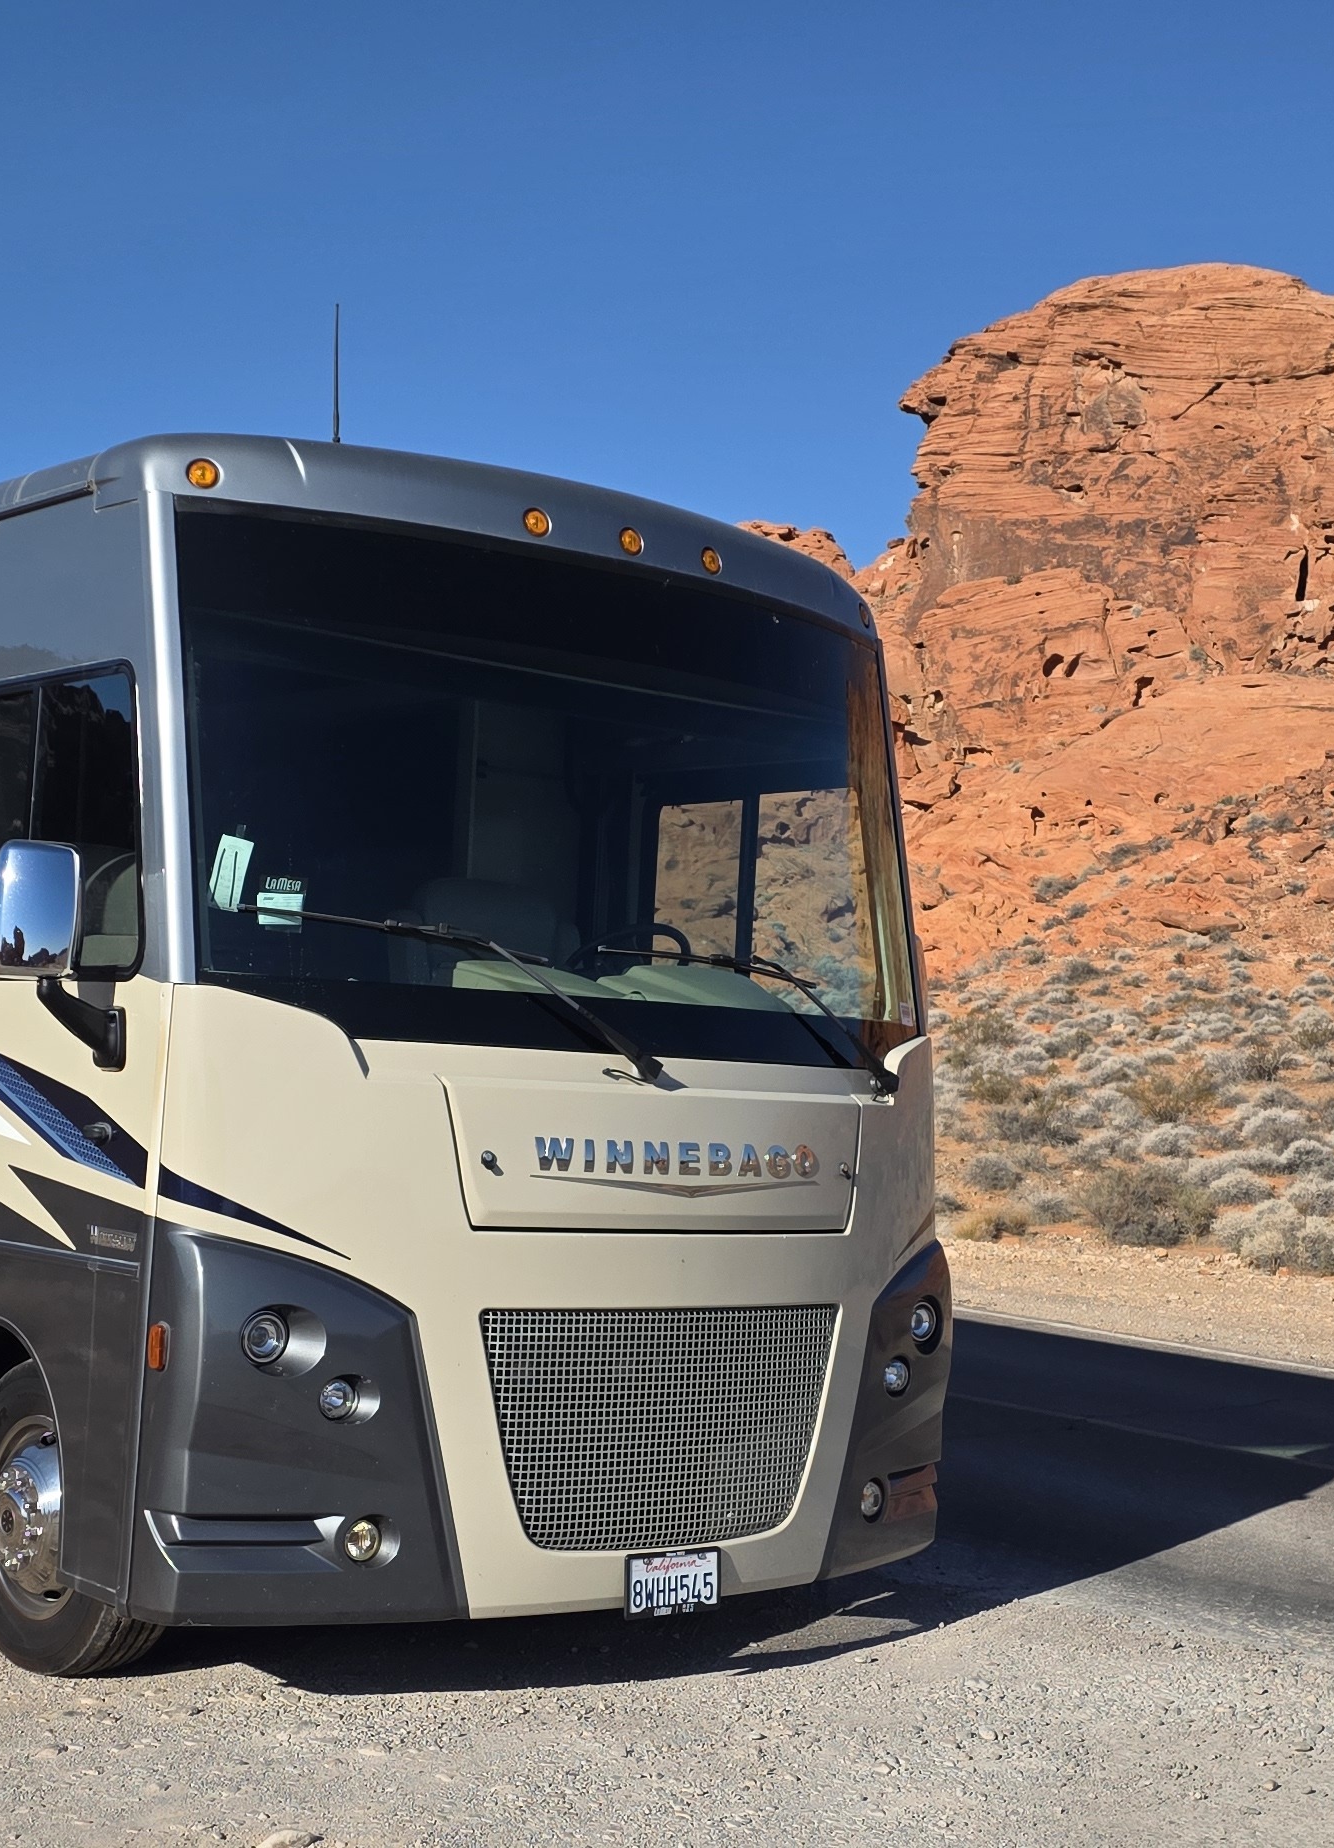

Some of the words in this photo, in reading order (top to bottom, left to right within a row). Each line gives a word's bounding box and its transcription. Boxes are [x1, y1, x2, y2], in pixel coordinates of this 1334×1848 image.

[534, 1136, 820, 1179] WINNEBAGO
[644, 1557, 703, 1575] California
[632, 1571, 714, 1609] 8WHH545
